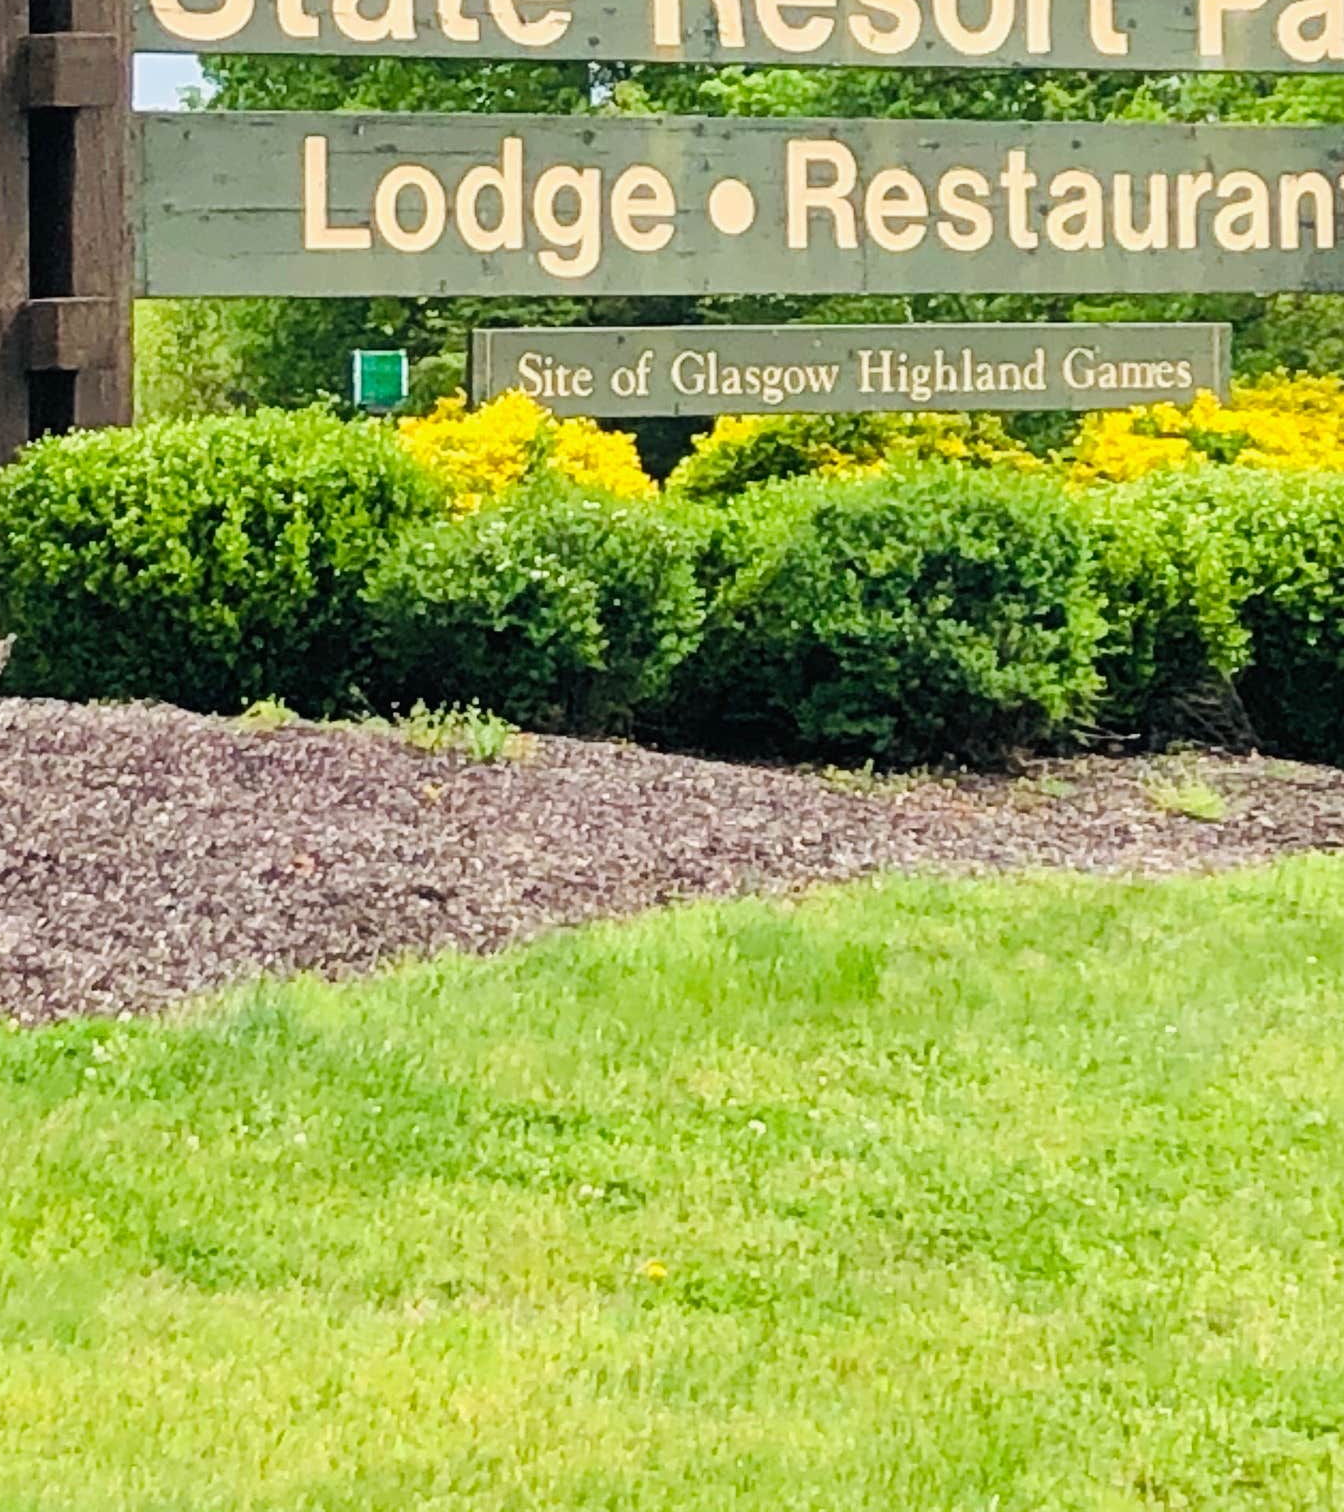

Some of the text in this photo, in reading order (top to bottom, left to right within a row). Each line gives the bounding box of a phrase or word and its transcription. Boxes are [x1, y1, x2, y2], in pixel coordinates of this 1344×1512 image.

[302, 135, 677, 279] Lodge
[518, 346, 1193, 405] Site of Glasgow Highland Games
